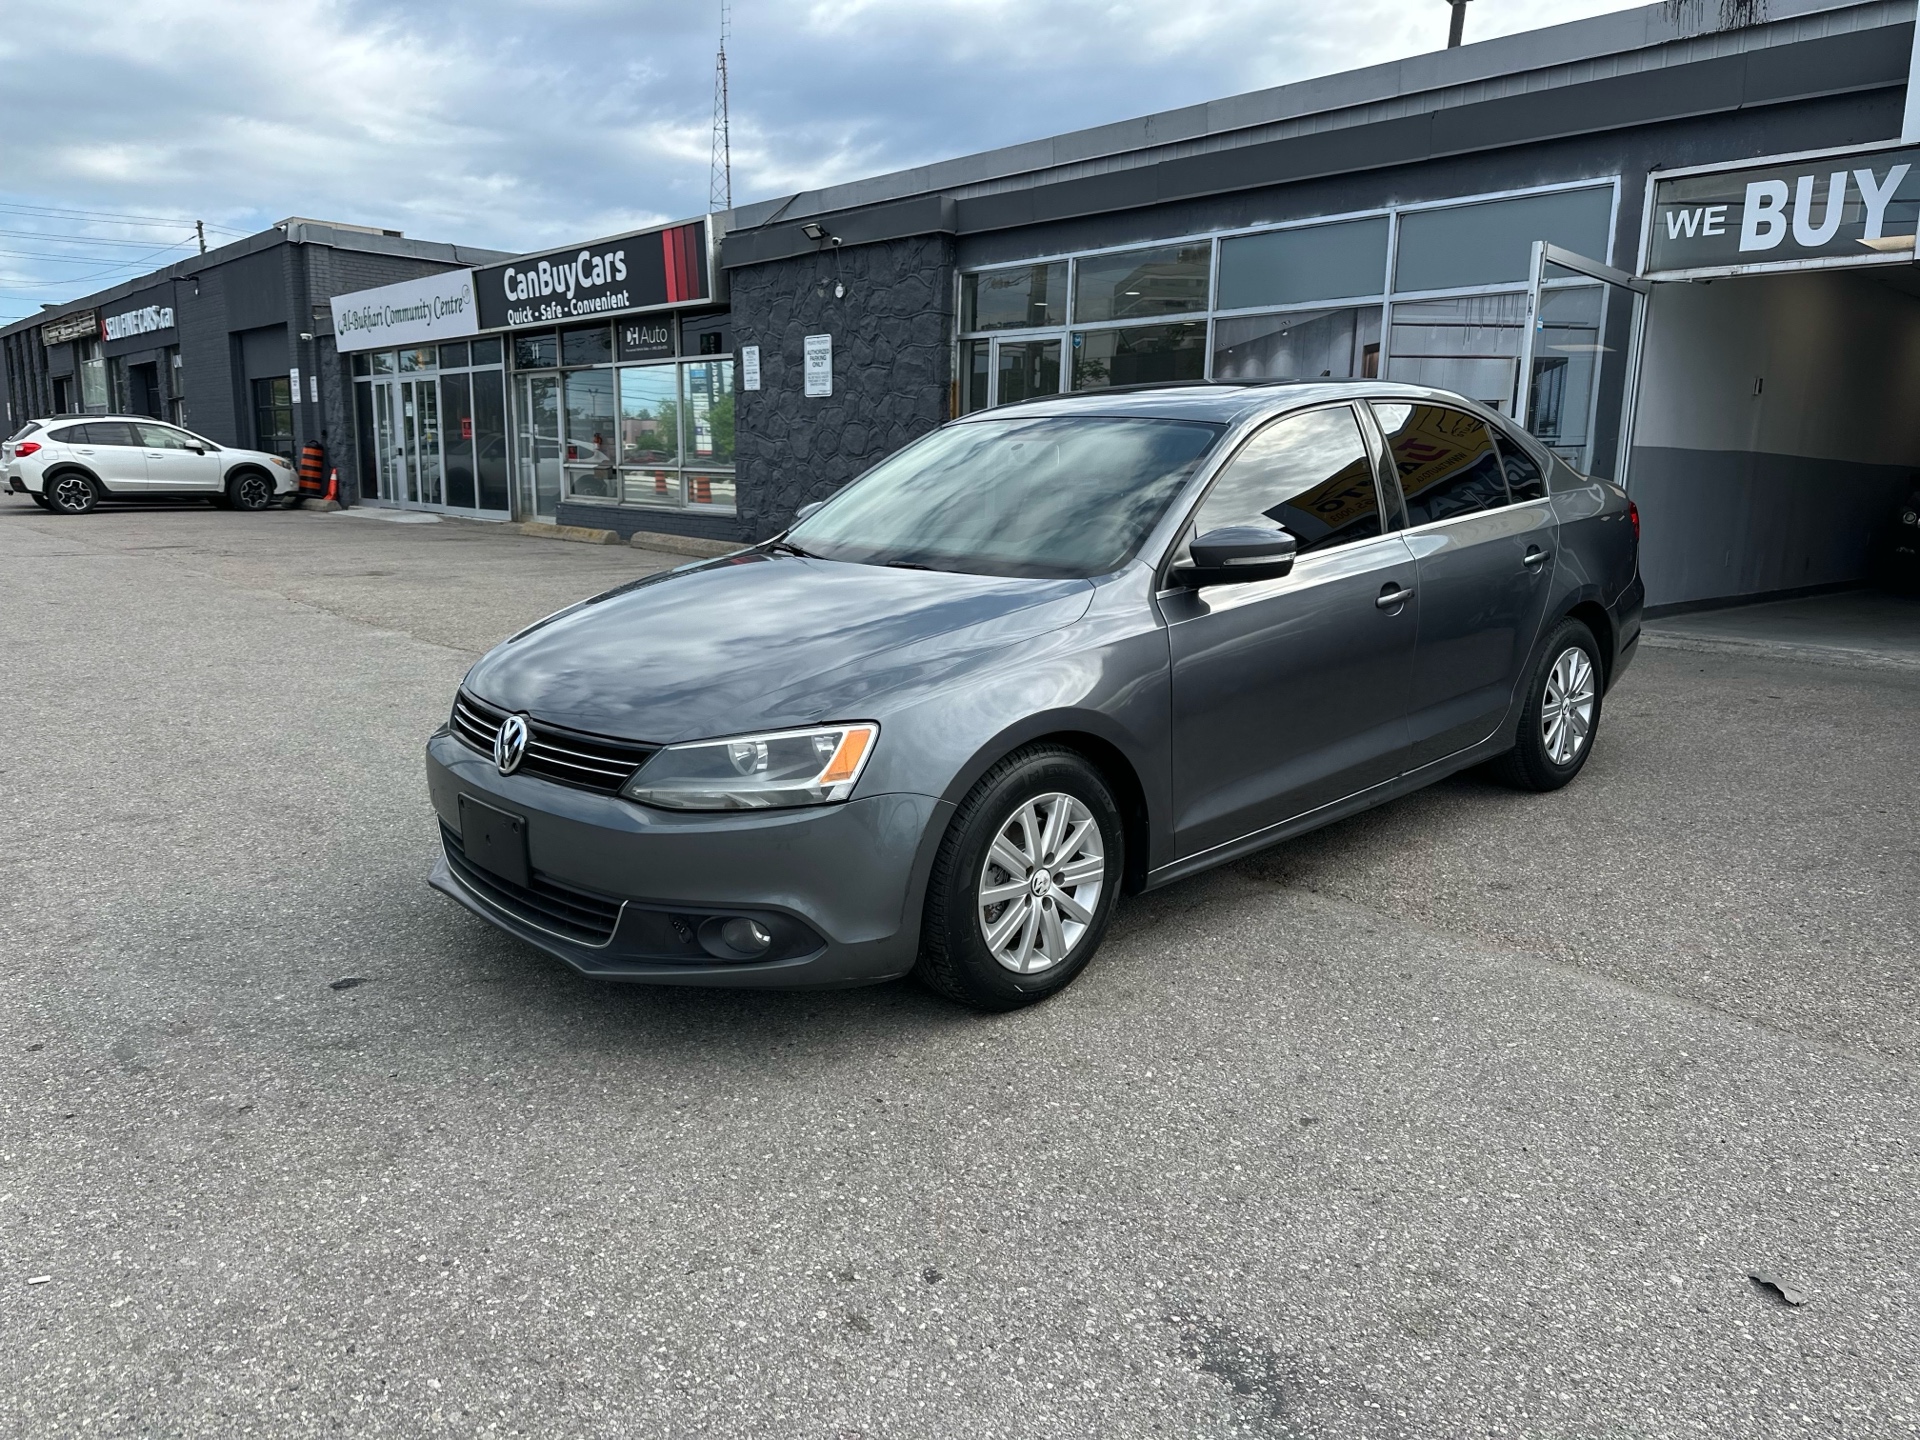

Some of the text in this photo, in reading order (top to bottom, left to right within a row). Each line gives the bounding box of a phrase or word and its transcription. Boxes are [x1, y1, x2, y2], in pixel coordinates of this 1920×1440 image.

[1666, 163, 1911, 252] WE BUY
[504, 251, 627, 301] CanBuyCars
[338, 287, 469, 336] Al-Bukhari Community Centre
[507, 306, 534, 326] Quick
[540, 302, 563, 320] Safe
[570, 290, 630, 315] Convenient
[640, 326, 668, 344] Auto
